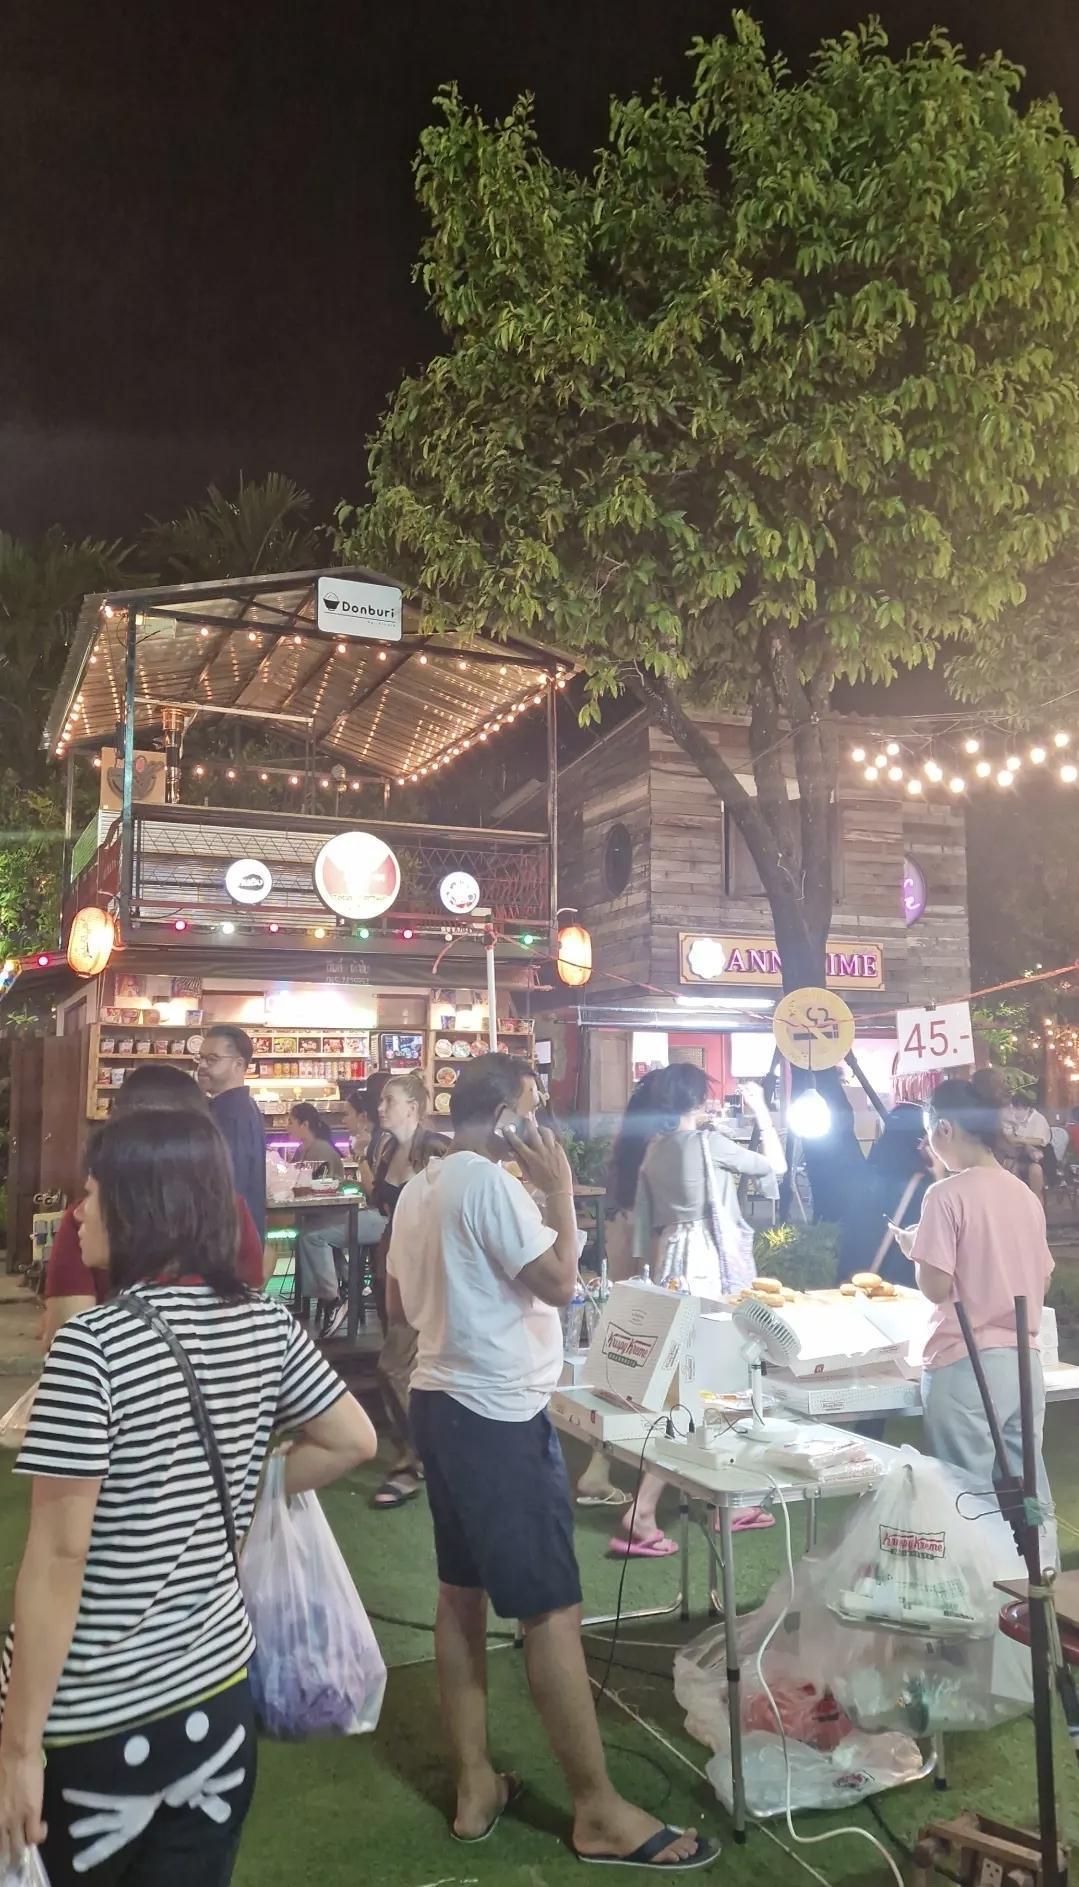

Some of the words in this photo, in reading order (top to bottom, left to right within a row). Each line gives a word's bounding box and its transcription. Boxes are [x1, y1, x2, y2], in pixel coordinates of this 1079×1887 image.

[342, 600, 395, 618] Donburi
[725, 947, 783, 974] ANN
[826, 952, 878, 977] IME
[904, 1020, 970, 1059] 45.-
